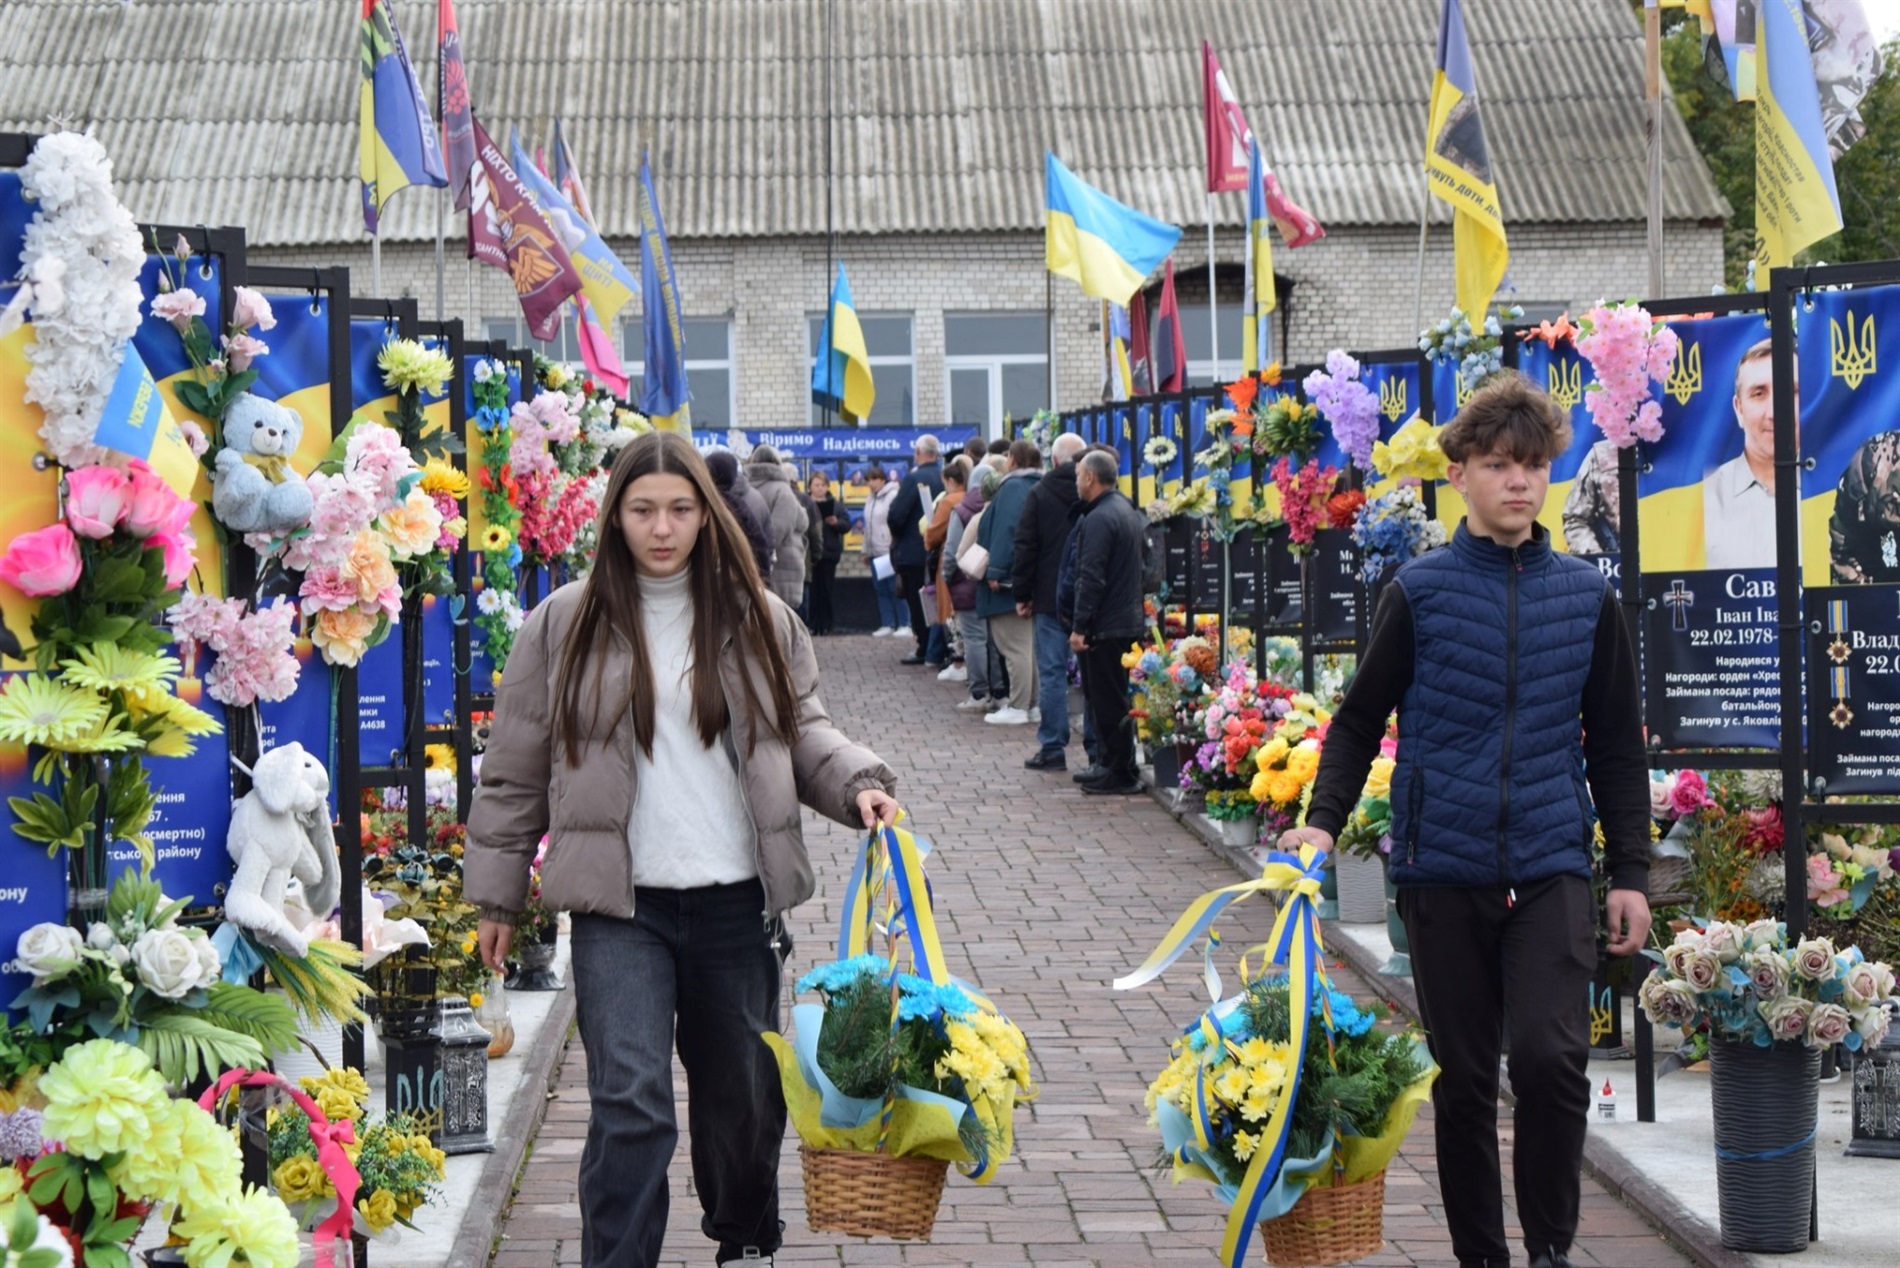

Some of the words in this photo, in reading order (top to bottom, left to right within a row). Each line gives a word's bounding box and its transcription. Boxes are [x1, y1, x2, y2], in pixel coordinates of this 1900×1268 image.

[481, 144, 518, 182] НІХТО
[759, 431, 814, 449] Віримо
[822, 436, 901, 452] Надіємось
[1716, 607, 1752, 624] Іван
[1716, 656, 1772, 668] Народився
[1774, 656, 1780, 668] у
[1665, 672, 1718, 684] Нагороди:
[1719, 671, 1750, 683] орден
[1665, 686, 1711, 697] Займана
[1713, 686, 1751, 698] посада:
[1680, 716, 1722, 728] Загинув
[1723, 717, 1731, 728] у
[1732, 717, 1741, 726] с.
[1837, 753, 1877, 764] Займана
[1879, 754, 1900, 765] поса
[1846, 766, 1883, 778] Загинув
[107, 850, 142, 860] сько
[157, 845, 202, 862] району
